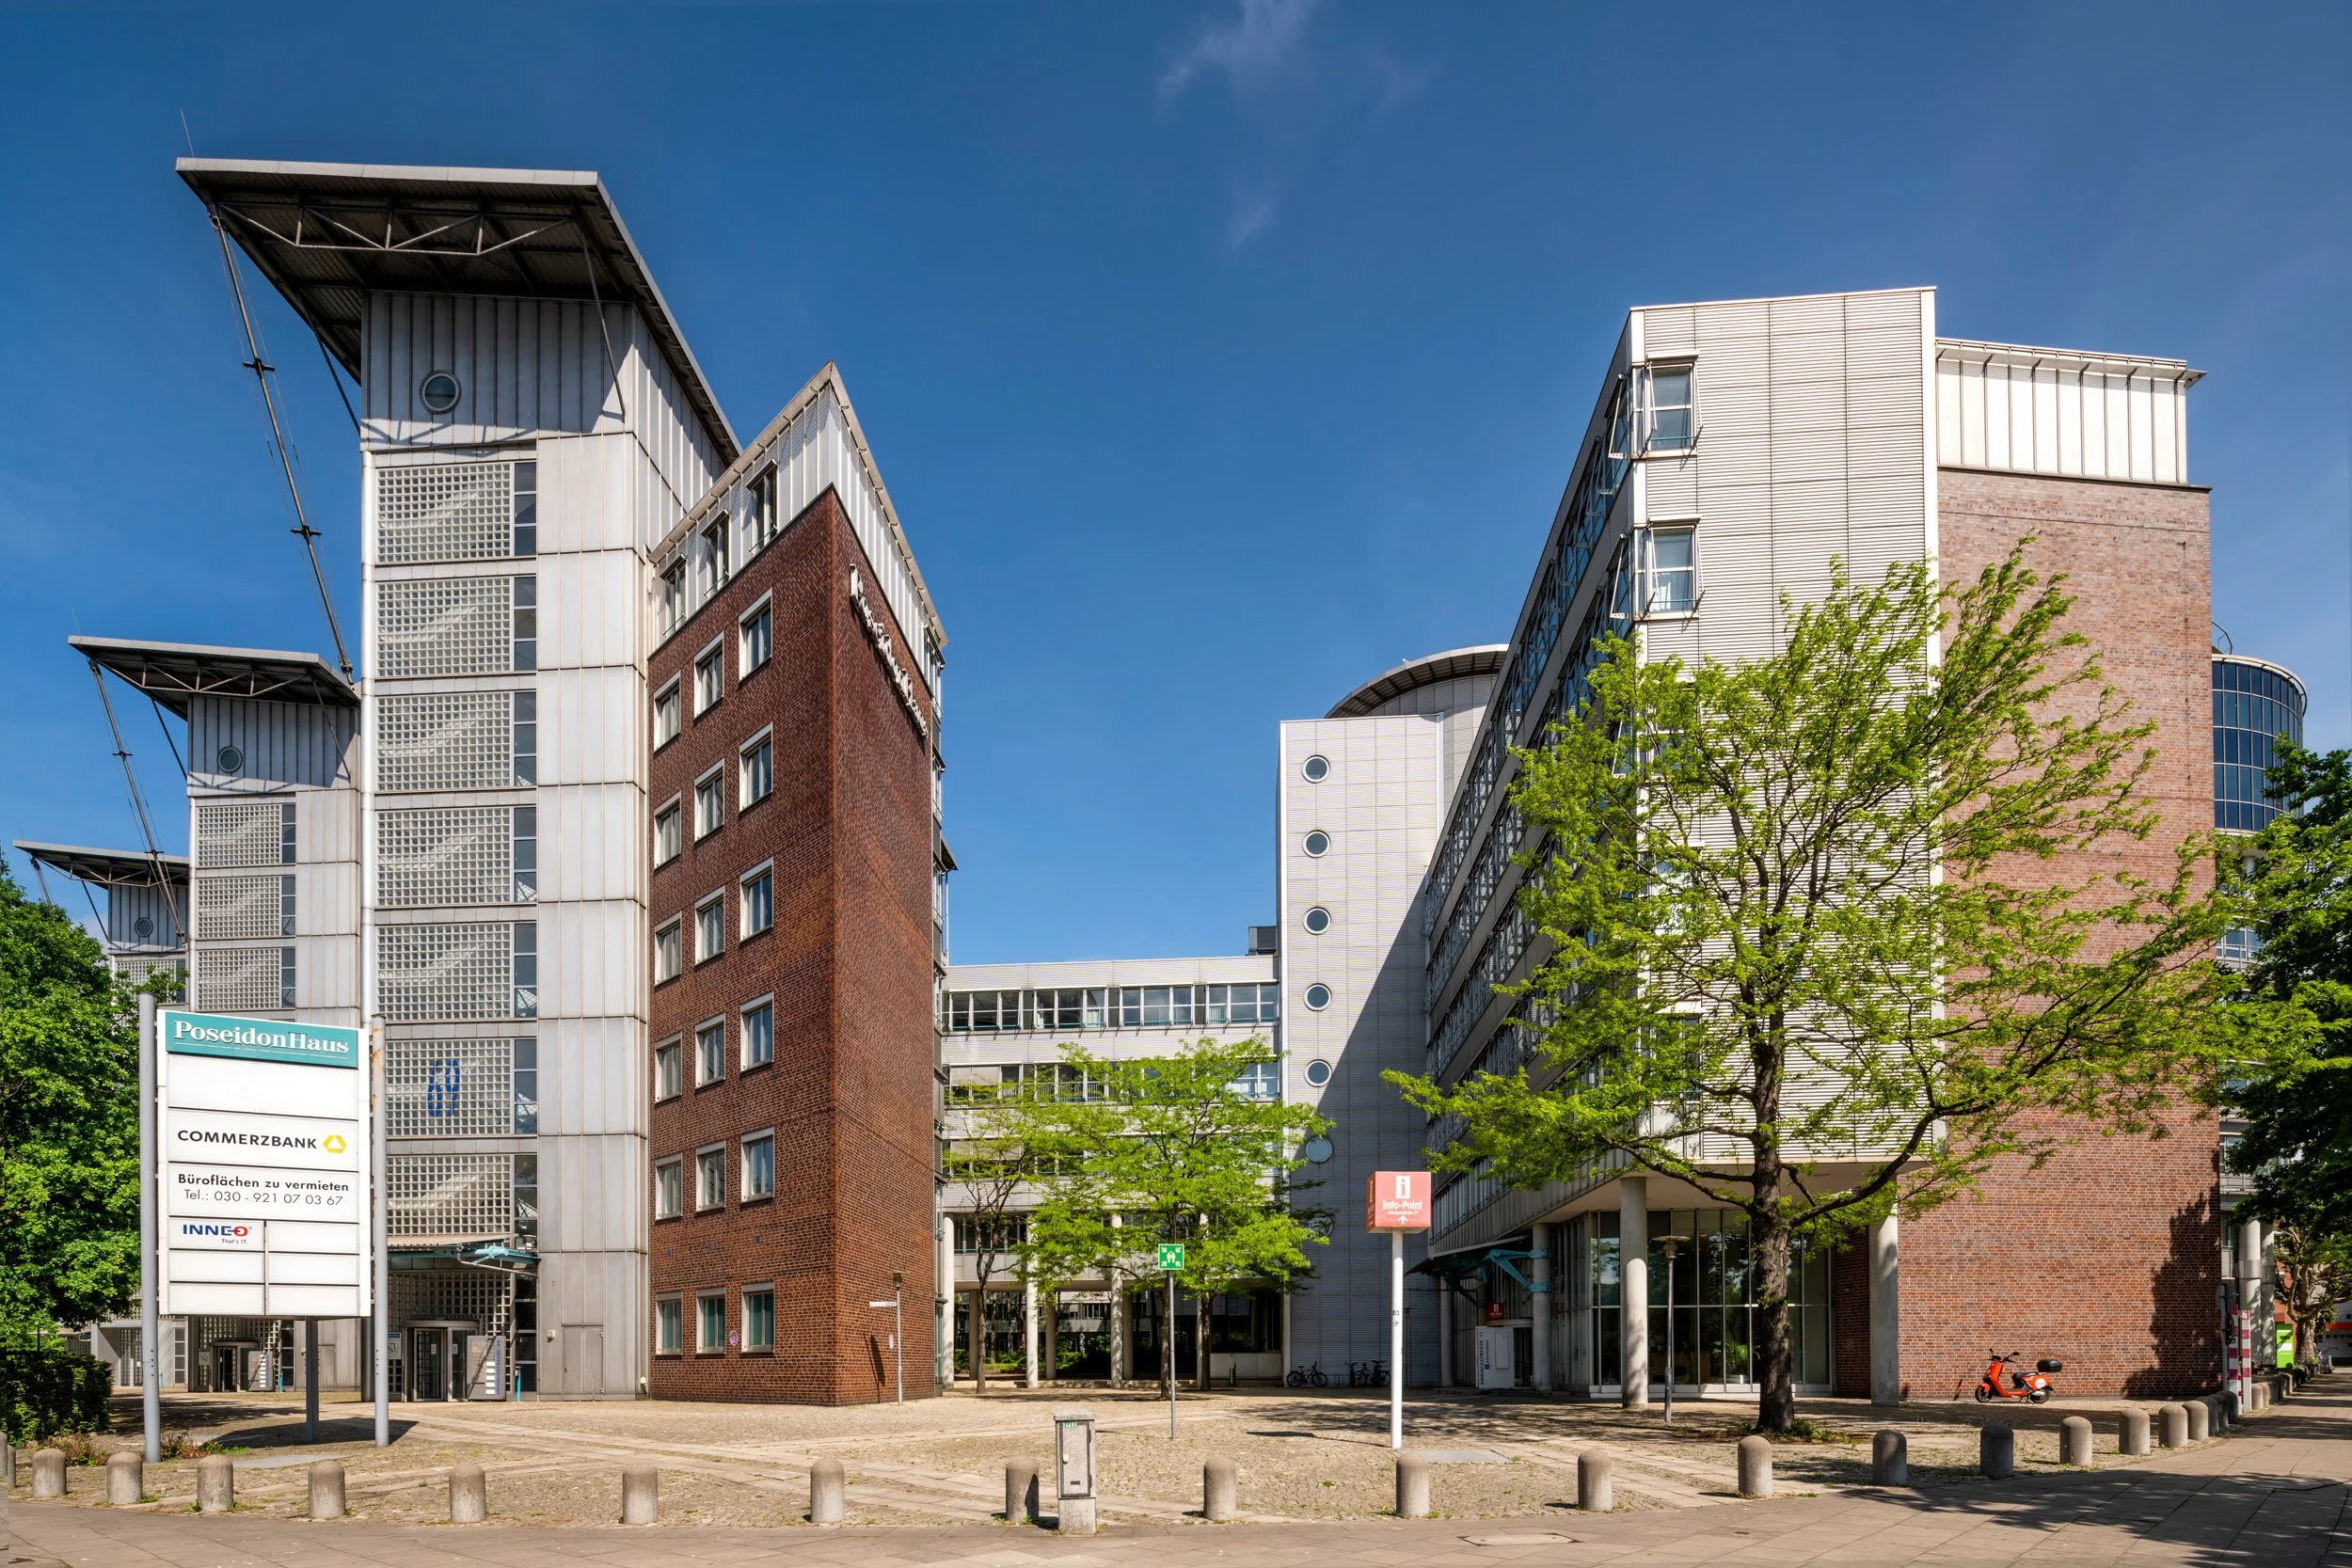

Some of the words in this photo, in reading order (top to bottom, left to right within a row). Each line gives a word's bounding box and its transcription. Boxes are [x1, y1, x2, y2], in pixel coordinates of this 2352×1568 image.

[173, 1020, 349, 1053] PoseidonHaus
[177, 1130, 317, 1148] COMMERZBANK
[178, 1173, 260, 1188] Büroflächen
[285, 1180, 349, 1192] vermieten
[184, 1189, 209, 1200] Tel.:
[214, 1190, 242, 1202] 030
[253, 1193, 277, 1203] 921
[283, 1194, 300, 1204] 07
[305, 1195, 322, 1205] 03
[326, 1196, 343, 1206] 67
[1383, 1200, 1422, 1210] Info-Point
